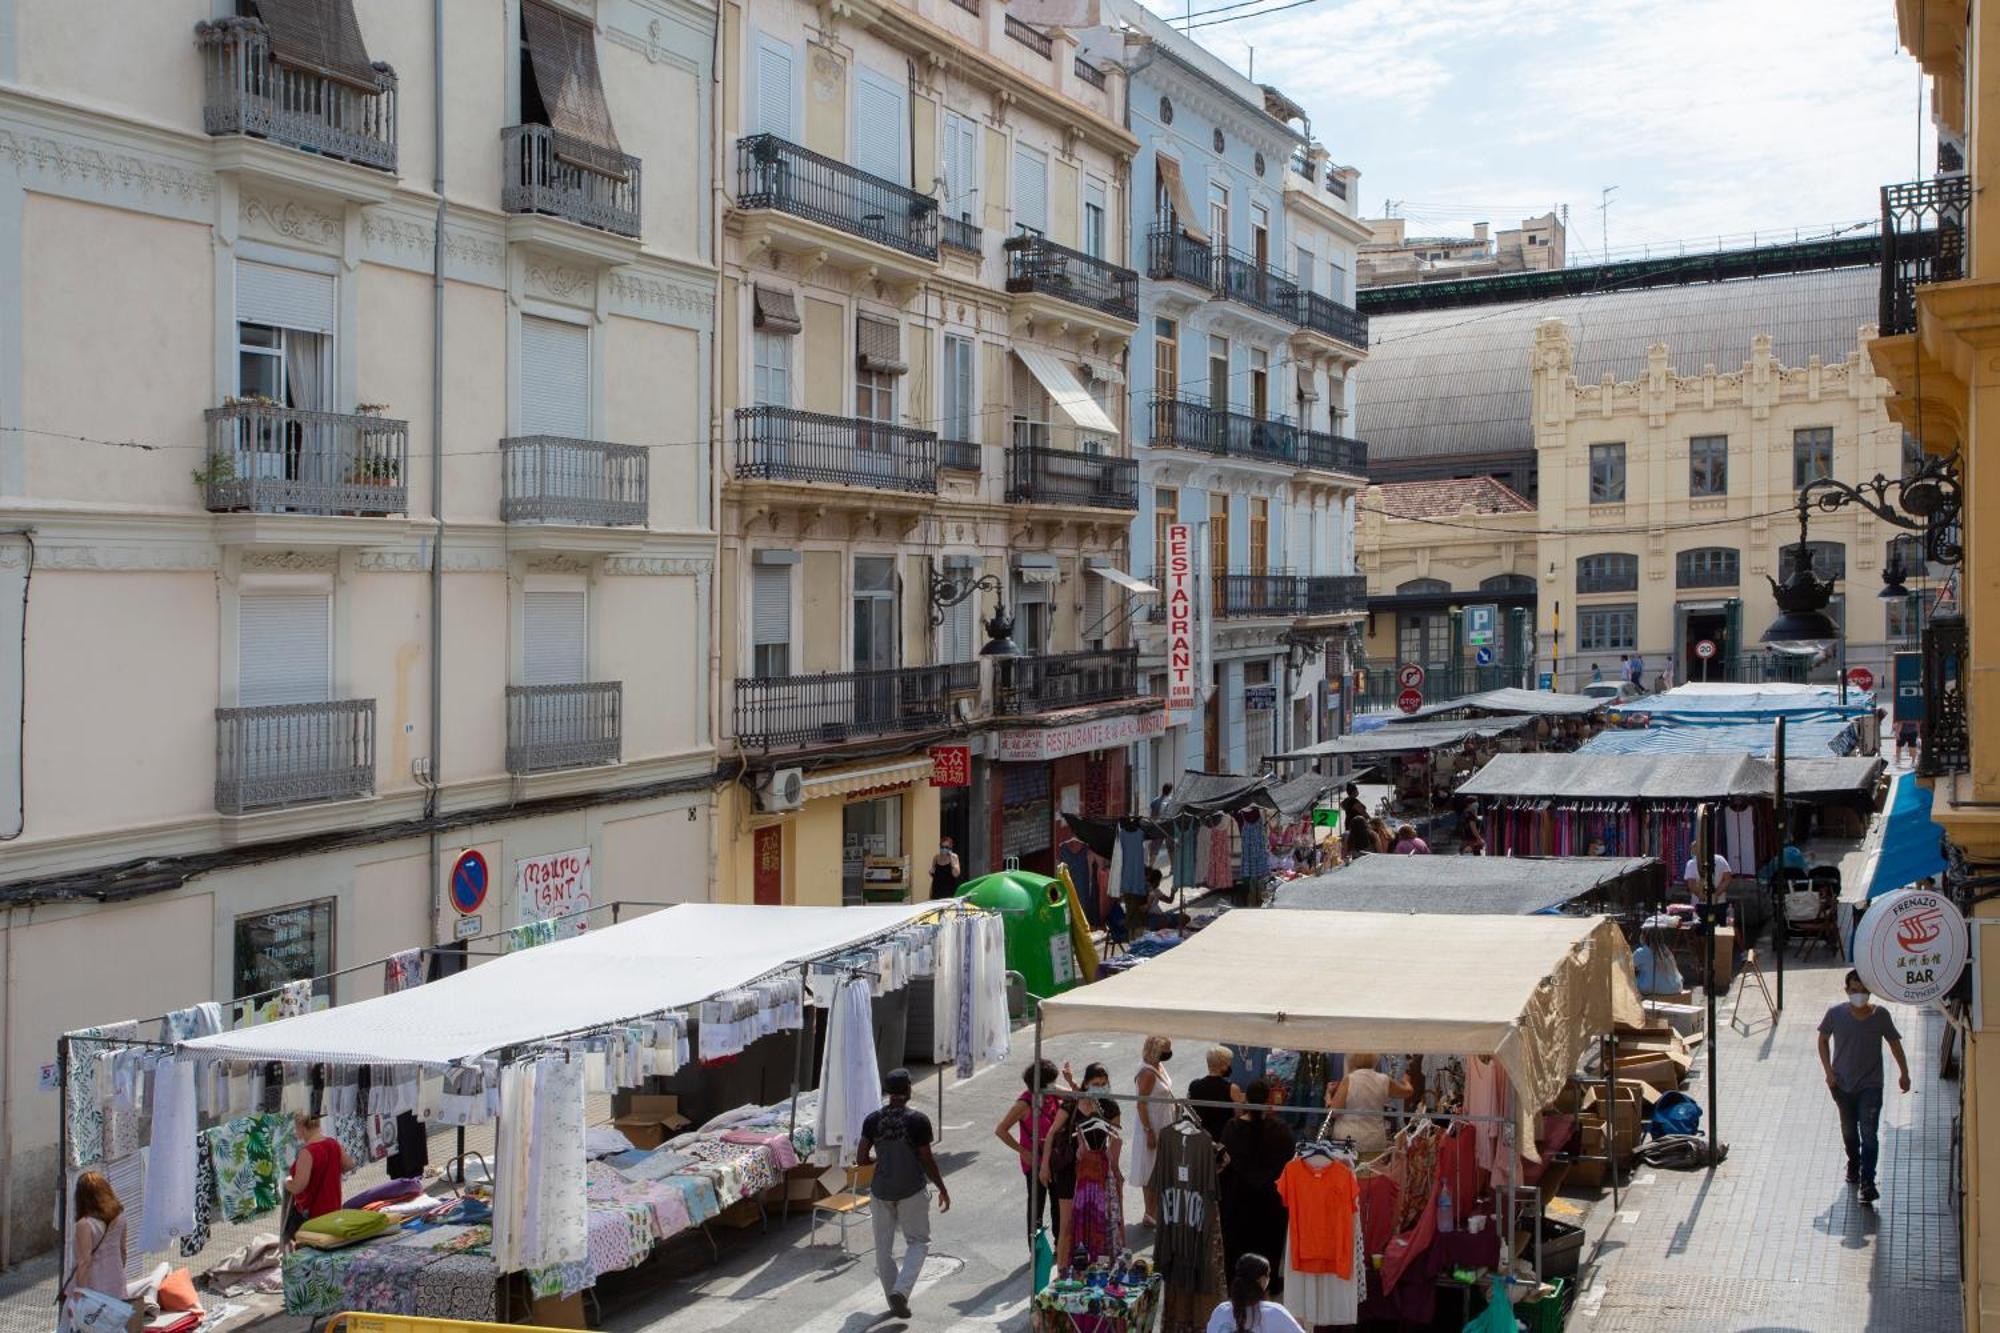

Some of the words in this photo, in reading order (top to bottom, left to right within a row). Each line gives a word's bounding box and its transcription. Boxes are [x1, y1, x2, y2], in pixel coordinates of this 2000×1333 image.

[1170, 526, 1190, 682] RESTAURANT
[1473, 610, 1488, 630] P
[1699, 645, 1712, 653] 20
[1399, 697, 1421, 705] STOP
[1046, 725, 1103, 752] RESTAURANTE
[1316, 812, 1329, 826] 2
[1893, 897, 1937, 916] FRENAZO
[1906, 969, 1934, 985] BAR
[1184, 1189, 1204, 1231] YOR
